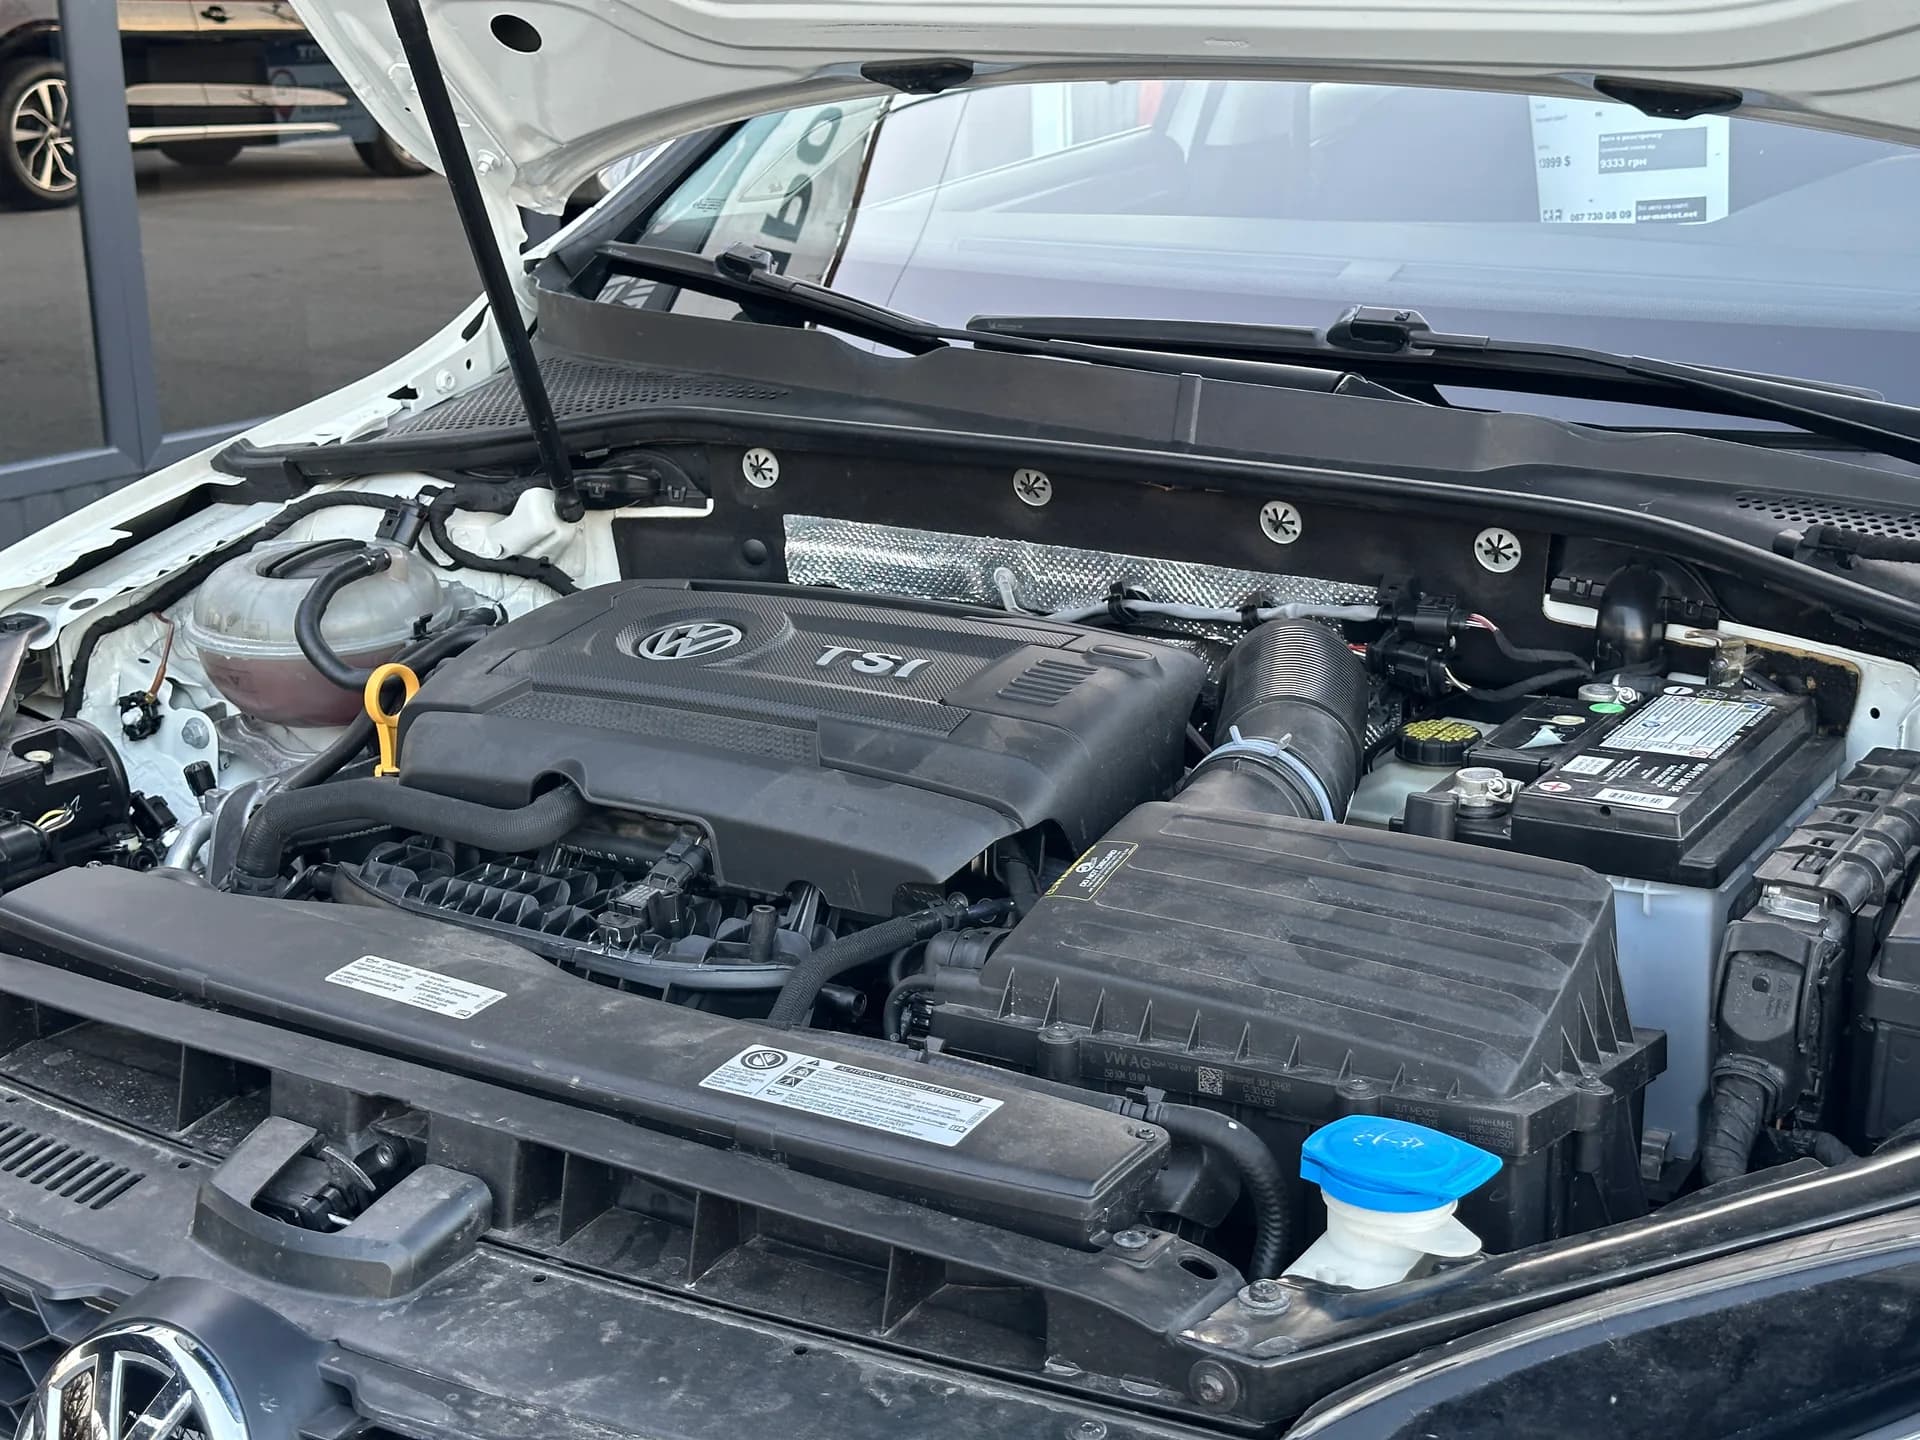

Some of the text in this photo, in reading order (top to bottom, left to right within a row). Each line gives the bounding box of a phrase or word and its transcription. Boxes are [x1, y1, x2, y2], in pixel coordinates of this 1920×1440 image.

[1563, 155, 1571, 167] $
[1600, 158, 1648, 168] 9333 грн
[815, 645, 932, 678] TSI
[1104, 1050, 1128, 1066] VW
[1129, 1055, 1151, 1070] AG
